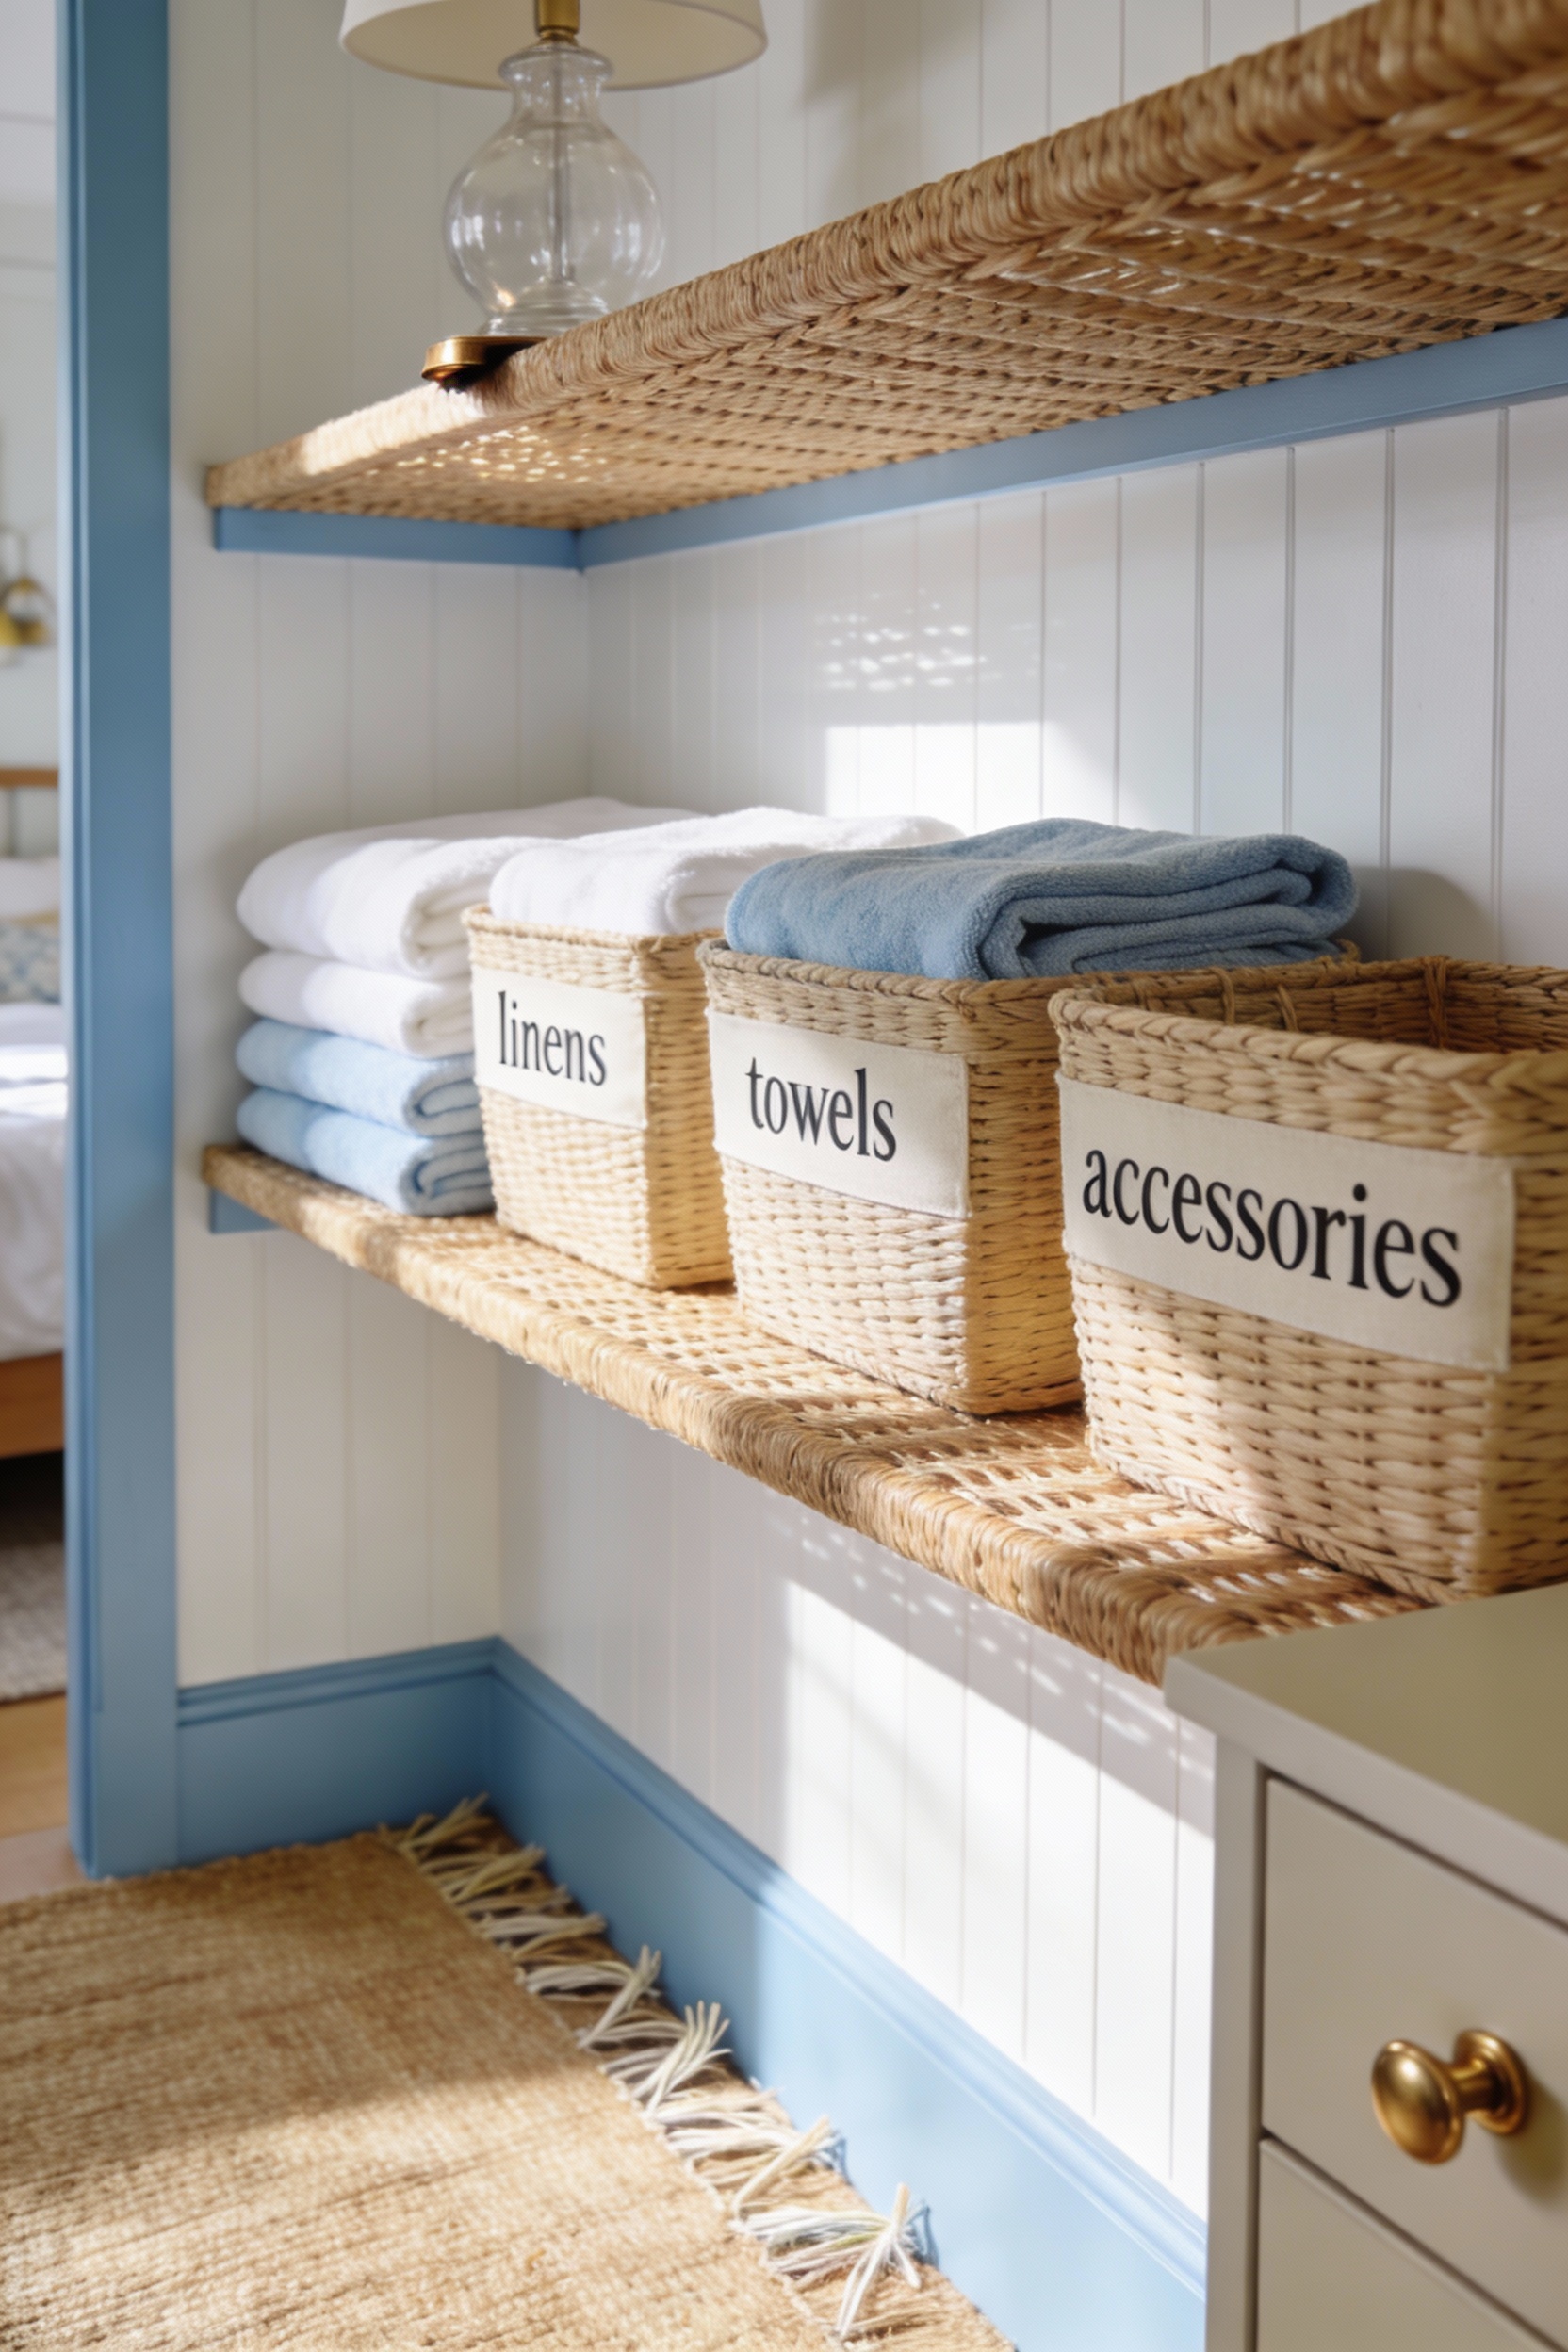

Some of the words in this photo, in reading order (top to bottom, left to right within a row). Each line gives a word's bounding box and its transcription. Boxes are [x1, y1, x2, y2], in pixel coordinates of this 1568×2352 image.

[498, 989, 608, 1087] linens
[744, 1056, 898, 1164] towels
[1081, 1148, 1463, 1309] accessories
